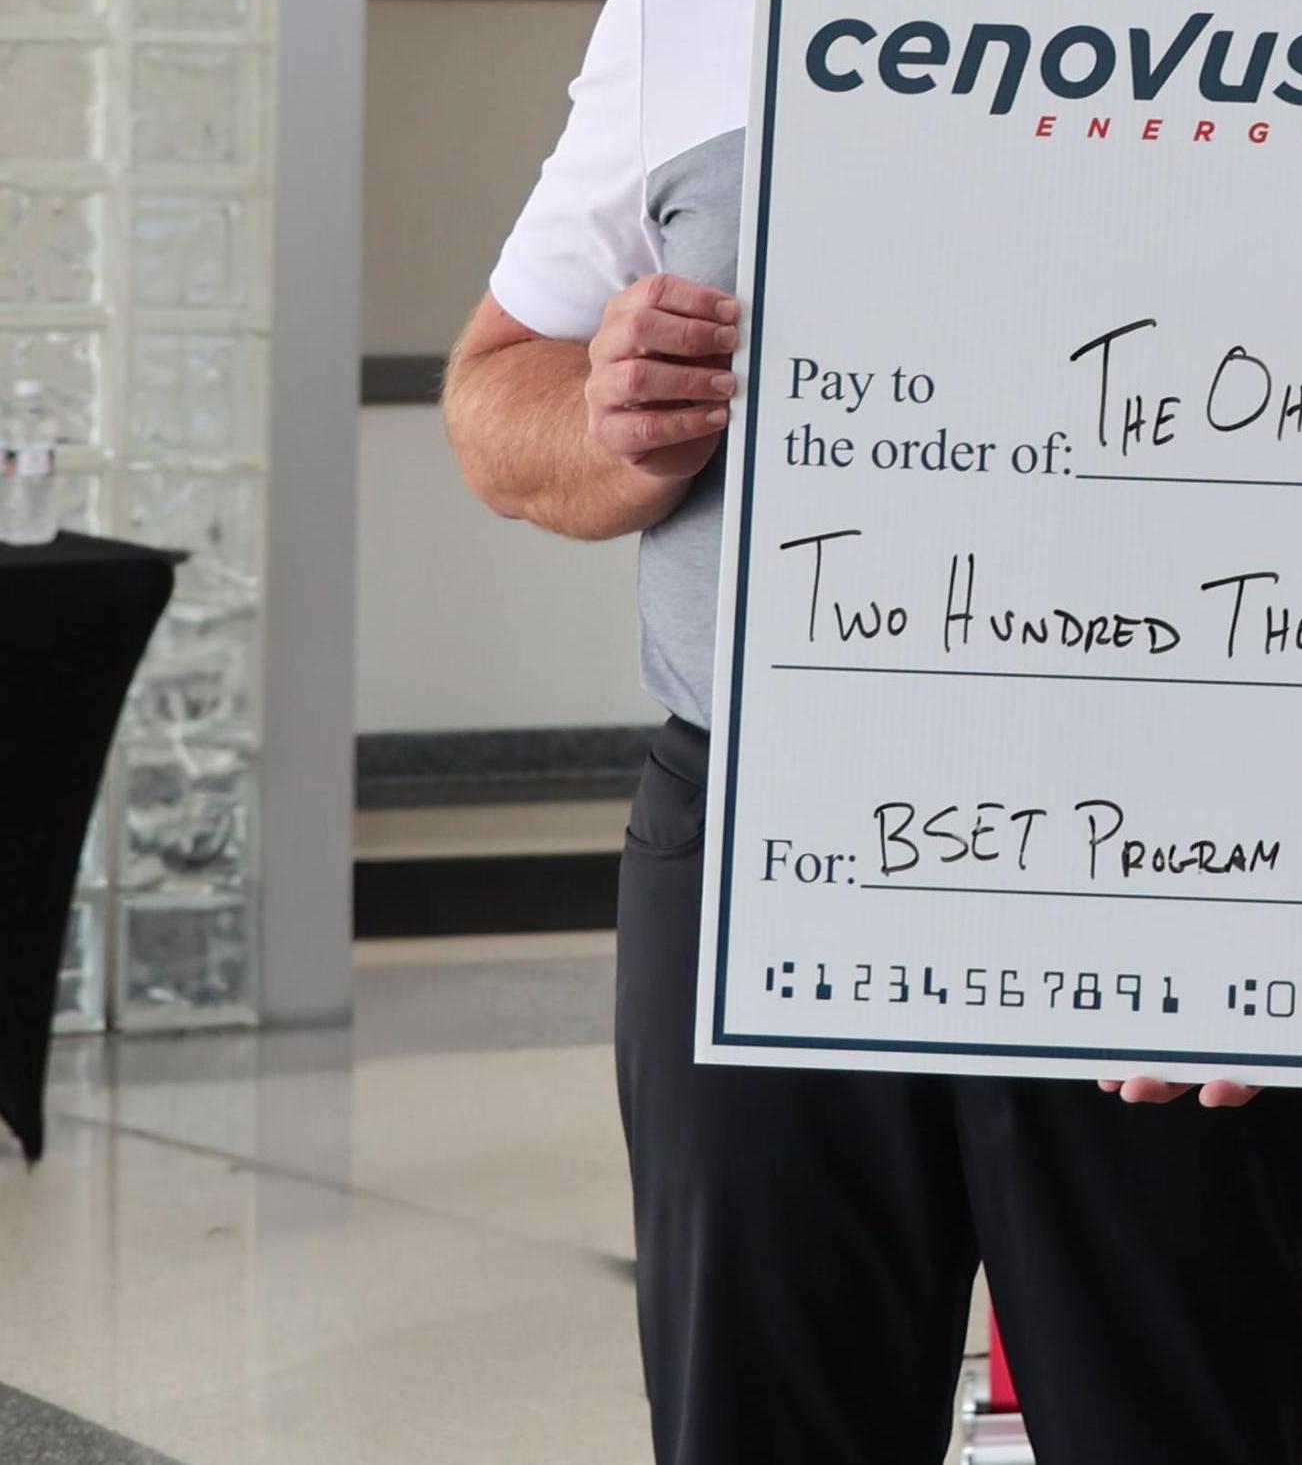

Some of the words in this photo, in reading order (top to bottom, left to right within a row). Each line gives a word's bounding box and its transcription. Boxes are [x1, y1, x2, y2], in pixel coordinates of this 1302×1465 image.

[789, 358, 874, 413] Pay
[892, 367, 934, 403] to
[1069, 319, 1180, 456] THE
[785, 424, 853, 467] the
[872, 428, 996, 471] order
[1012, 432, 1071, 475] of:
[780, 530, 907, 641] TWO
[945, 553, 1180, 654] HUNDRED
[763, 840, 855, 884] For:
[874, 803, 1047, 876] BSET
